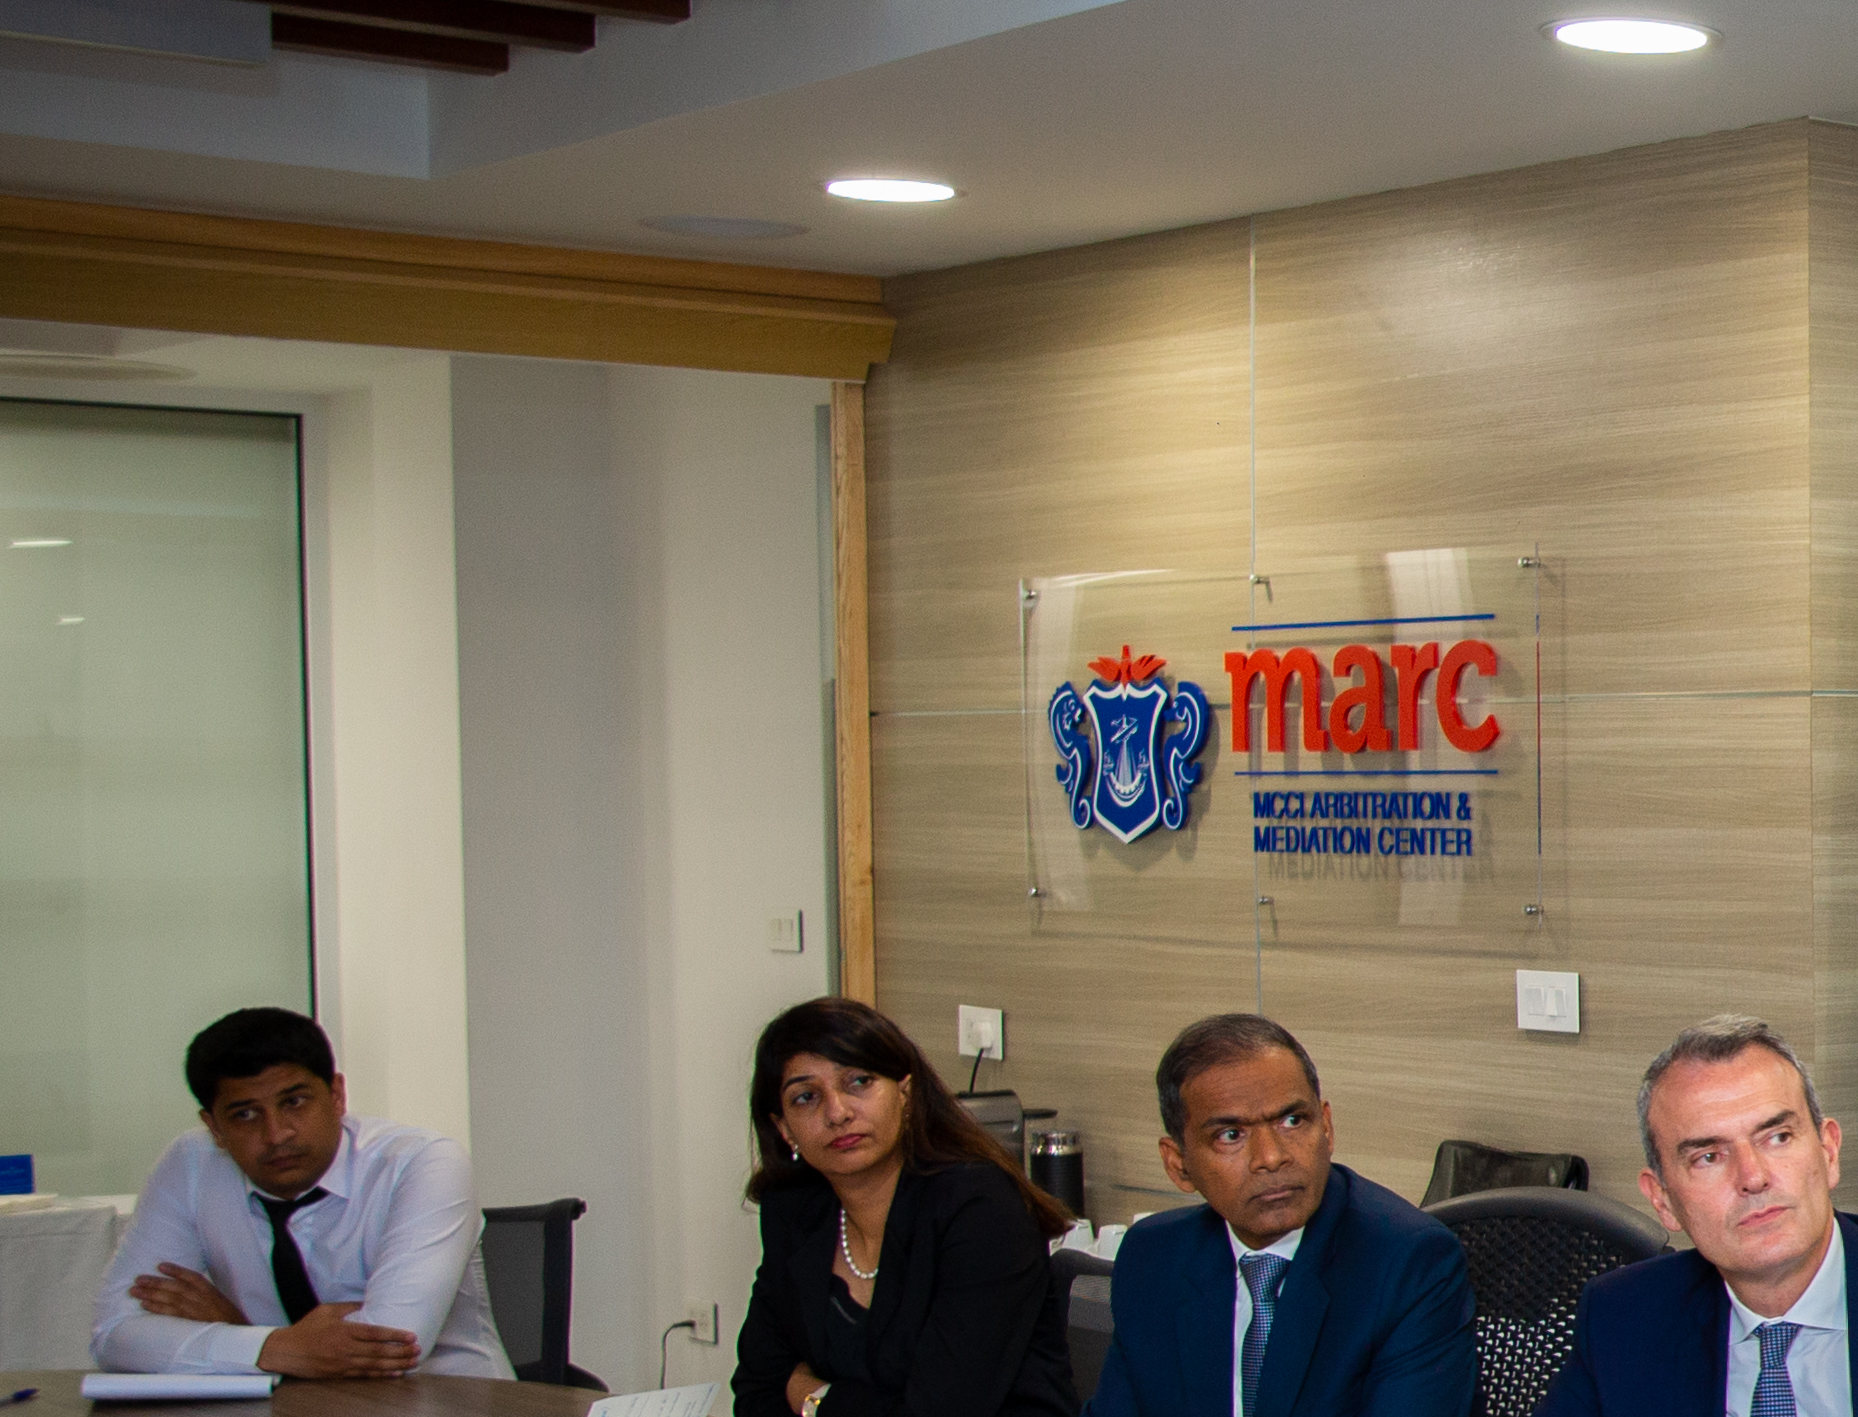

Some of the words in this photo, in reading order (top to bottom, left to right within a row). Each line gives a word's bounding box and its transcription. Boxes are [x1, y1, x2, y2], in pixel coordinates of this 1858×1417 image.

[1224, 639, 1501, 755] marc
[1253, 791, 1304, 819] MCCI
[1309, 791, 1450, 820] ARBITRATION
[1456, 792, 1471, 821] &
[1253, 826, 1371, 854] MEDIATION
[1378, 827, 1472, 856] CENTER
